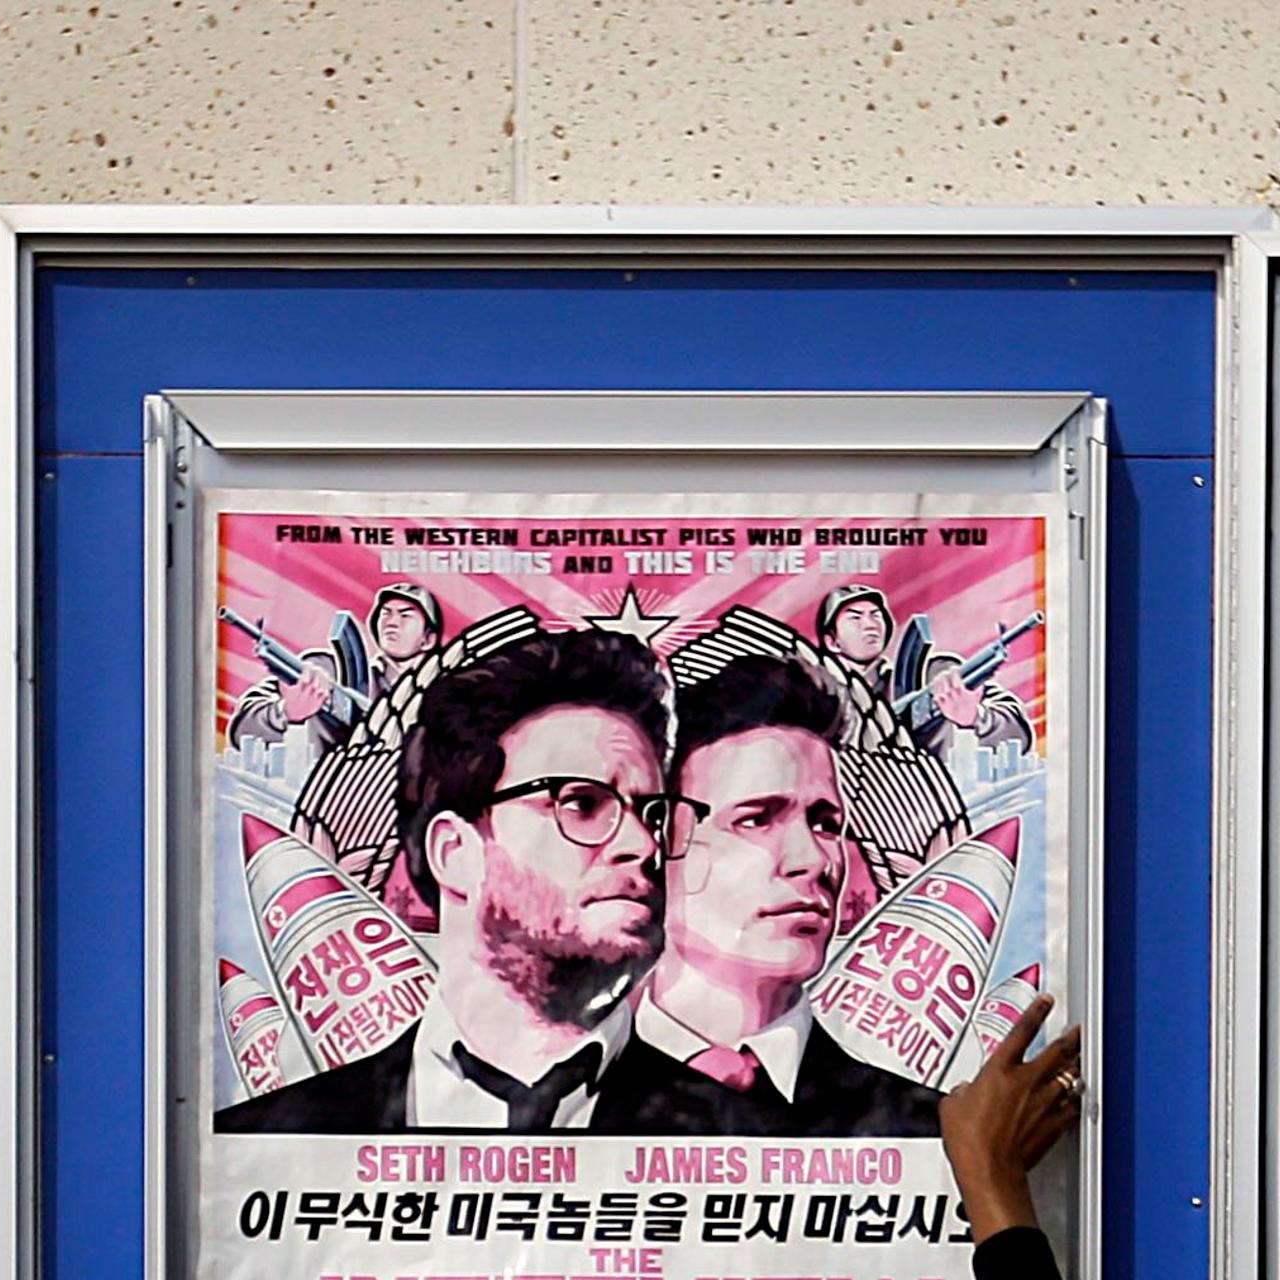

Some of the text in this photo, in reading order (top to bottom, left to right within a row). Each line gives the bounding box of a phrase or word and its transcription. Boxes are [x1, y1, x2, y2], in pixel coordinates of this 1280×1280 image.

[276, 524, 988, 547] FROM THE WESTERN CAPITALIST PIGS WHO BROUGHT YOU
[380, 550, 881, 576] NEIGHBORS AND THIS IS THE END
[285, 917, 422, 1034] 전쟁은
[844, 921, 976, 1041] 전쟁은
[357, 1144, 903, 1186] SETH ROGEN JAMES FRANCO
[701, 1191, 794, 1243] 믿지
[589, 1248, 663, 1274] THE
